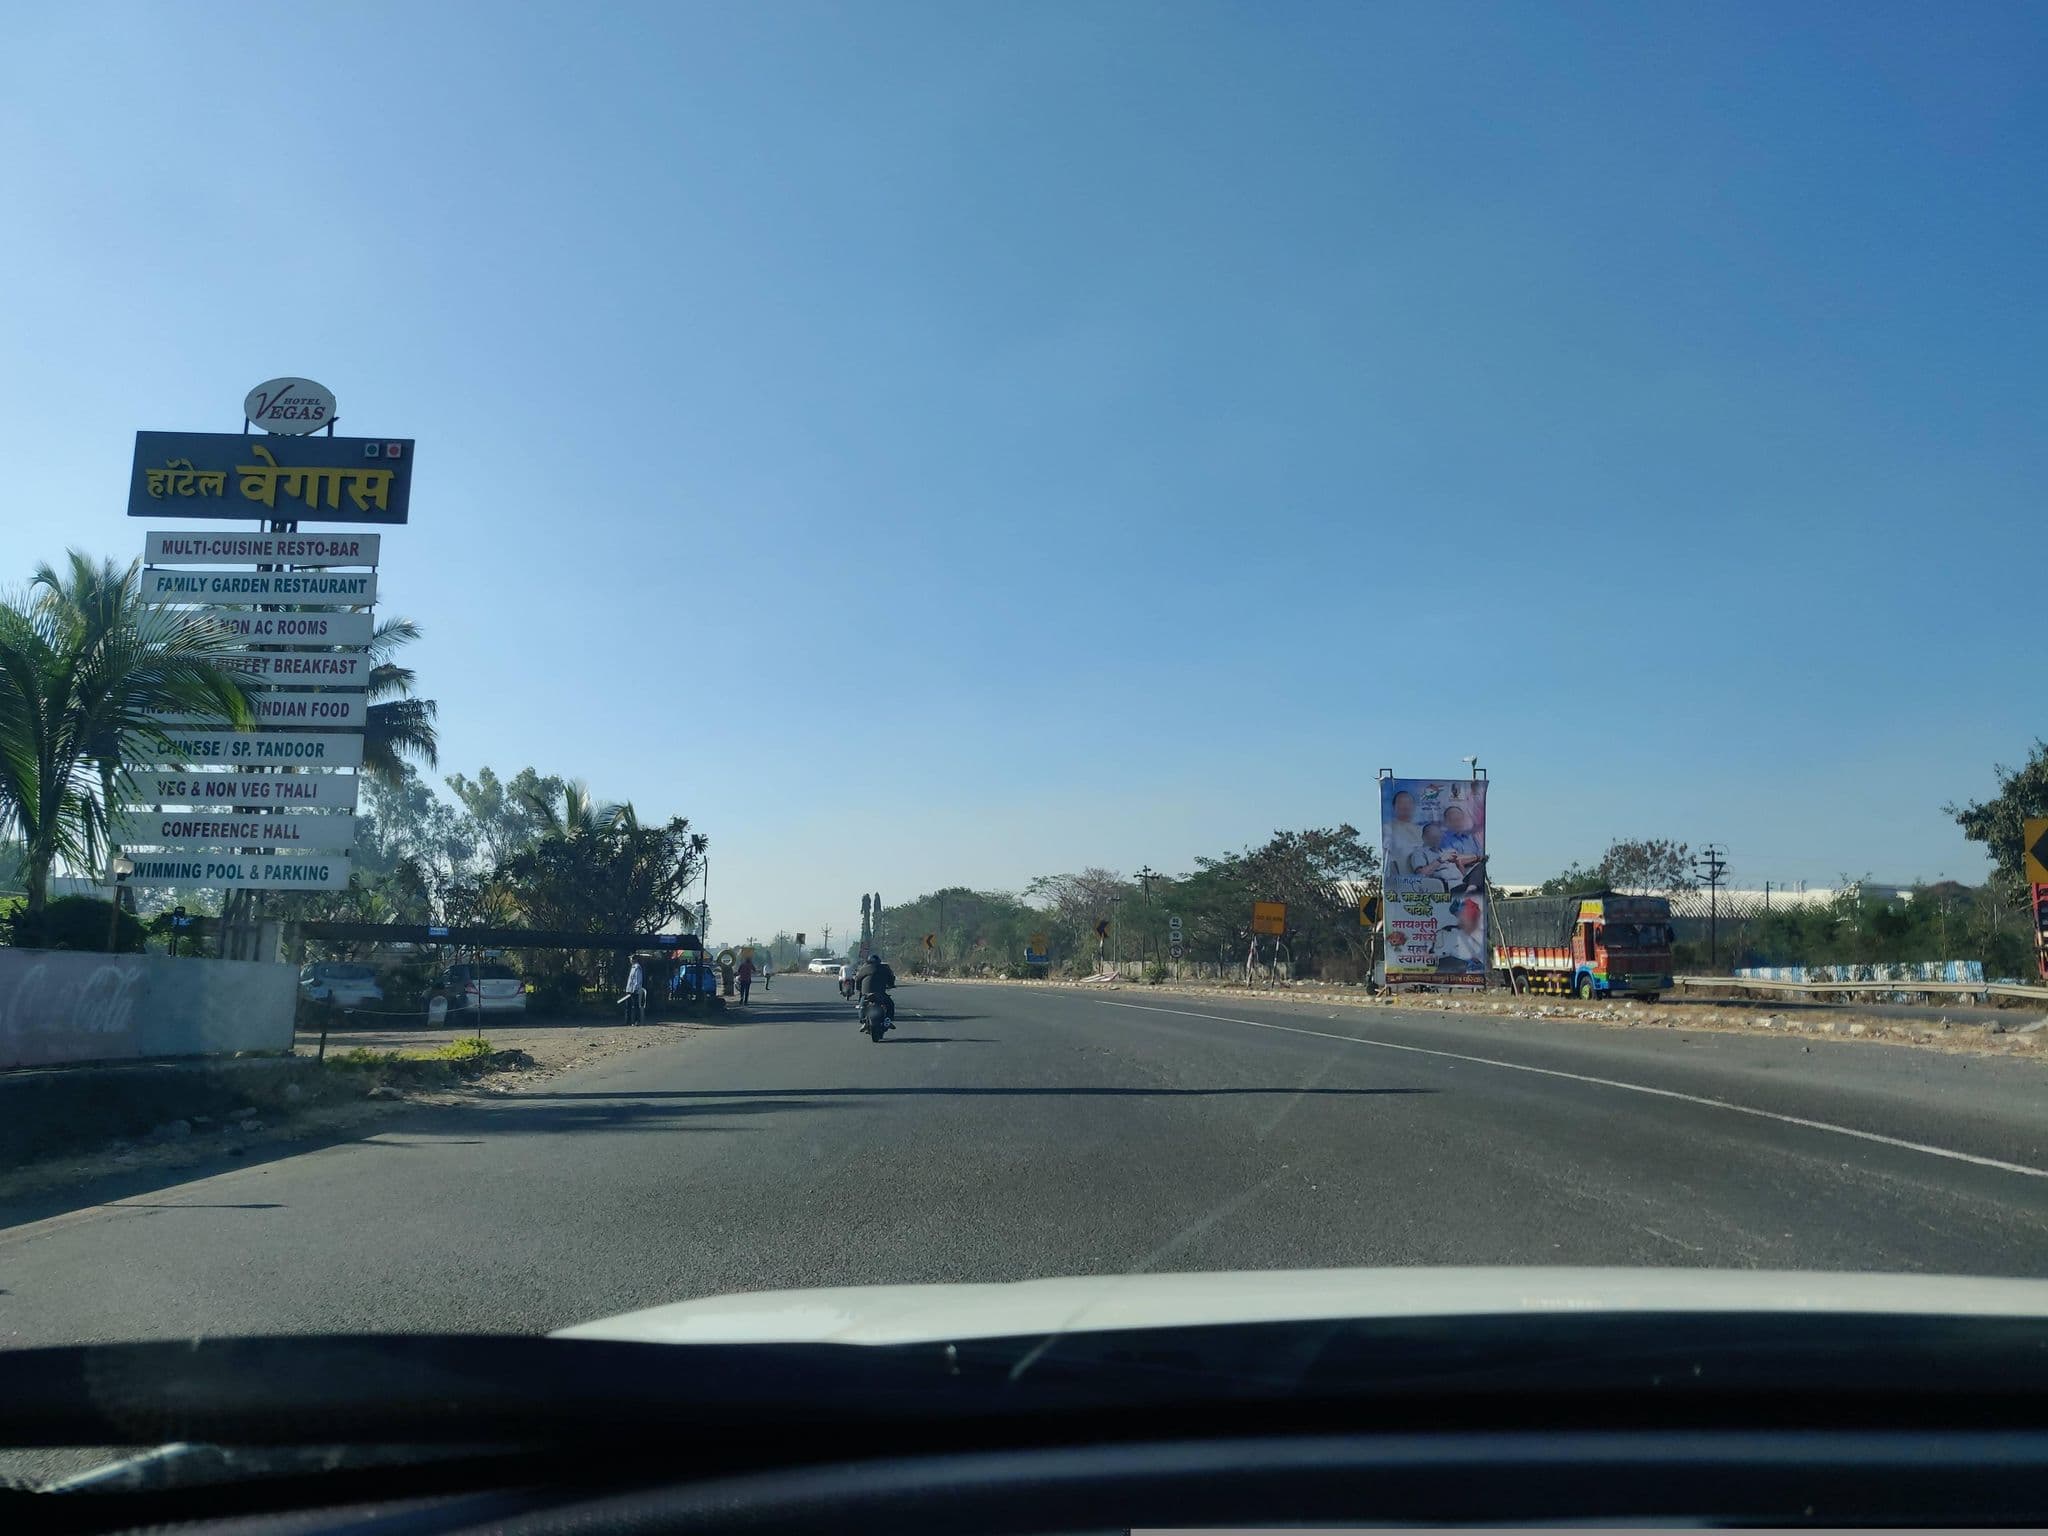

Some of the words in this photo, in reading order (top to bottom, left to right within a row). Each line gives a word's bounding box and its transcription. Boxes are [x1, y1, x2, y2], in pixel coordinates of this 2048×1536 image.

[256, 384, 326, 420] VEGAS
[284, 398, 321, 406] HOTEL
[145, 458, 227, 499] हॉटेल
[235, 444, 394, 511] वेगास
[162, 540, 272, 556] MULTI-CUISINE
[277, 541, 359, 557] RESTO-BAR
[157, 577, 207, 593] FAMILY
[212, 577, 269, 593] GARDEN
[274, 578, 367, 594] RESTAURANT
[254, 620, 273, 635] AC
[278, 620, 328, 635] ROOMS
[274, 659, 357, 674] BREAKFAST
[257, 702, 307, 717] INDIAN
[311, 703, 349, 717] FOOD
[232, 741, 251, 756] SP.
[257, 741, 324, 757] TANDOOR
[157, 781, 185, 796] VEG
[191, 781, 200, 796] &
[206, 782, 237, 797] NON
[242, 782, 270, 797] VEG
[275, 783, 317, 798] THALI
[162, 821, 258, 838] CONFERENCE
[263, 823, 300, 839] HALL
[132, 862, 201, 878] WIMMING
[207, 863, 244, 879] POOL
[250, 864, 259, 879] &
[265, 864, 328, 881] PARKING
